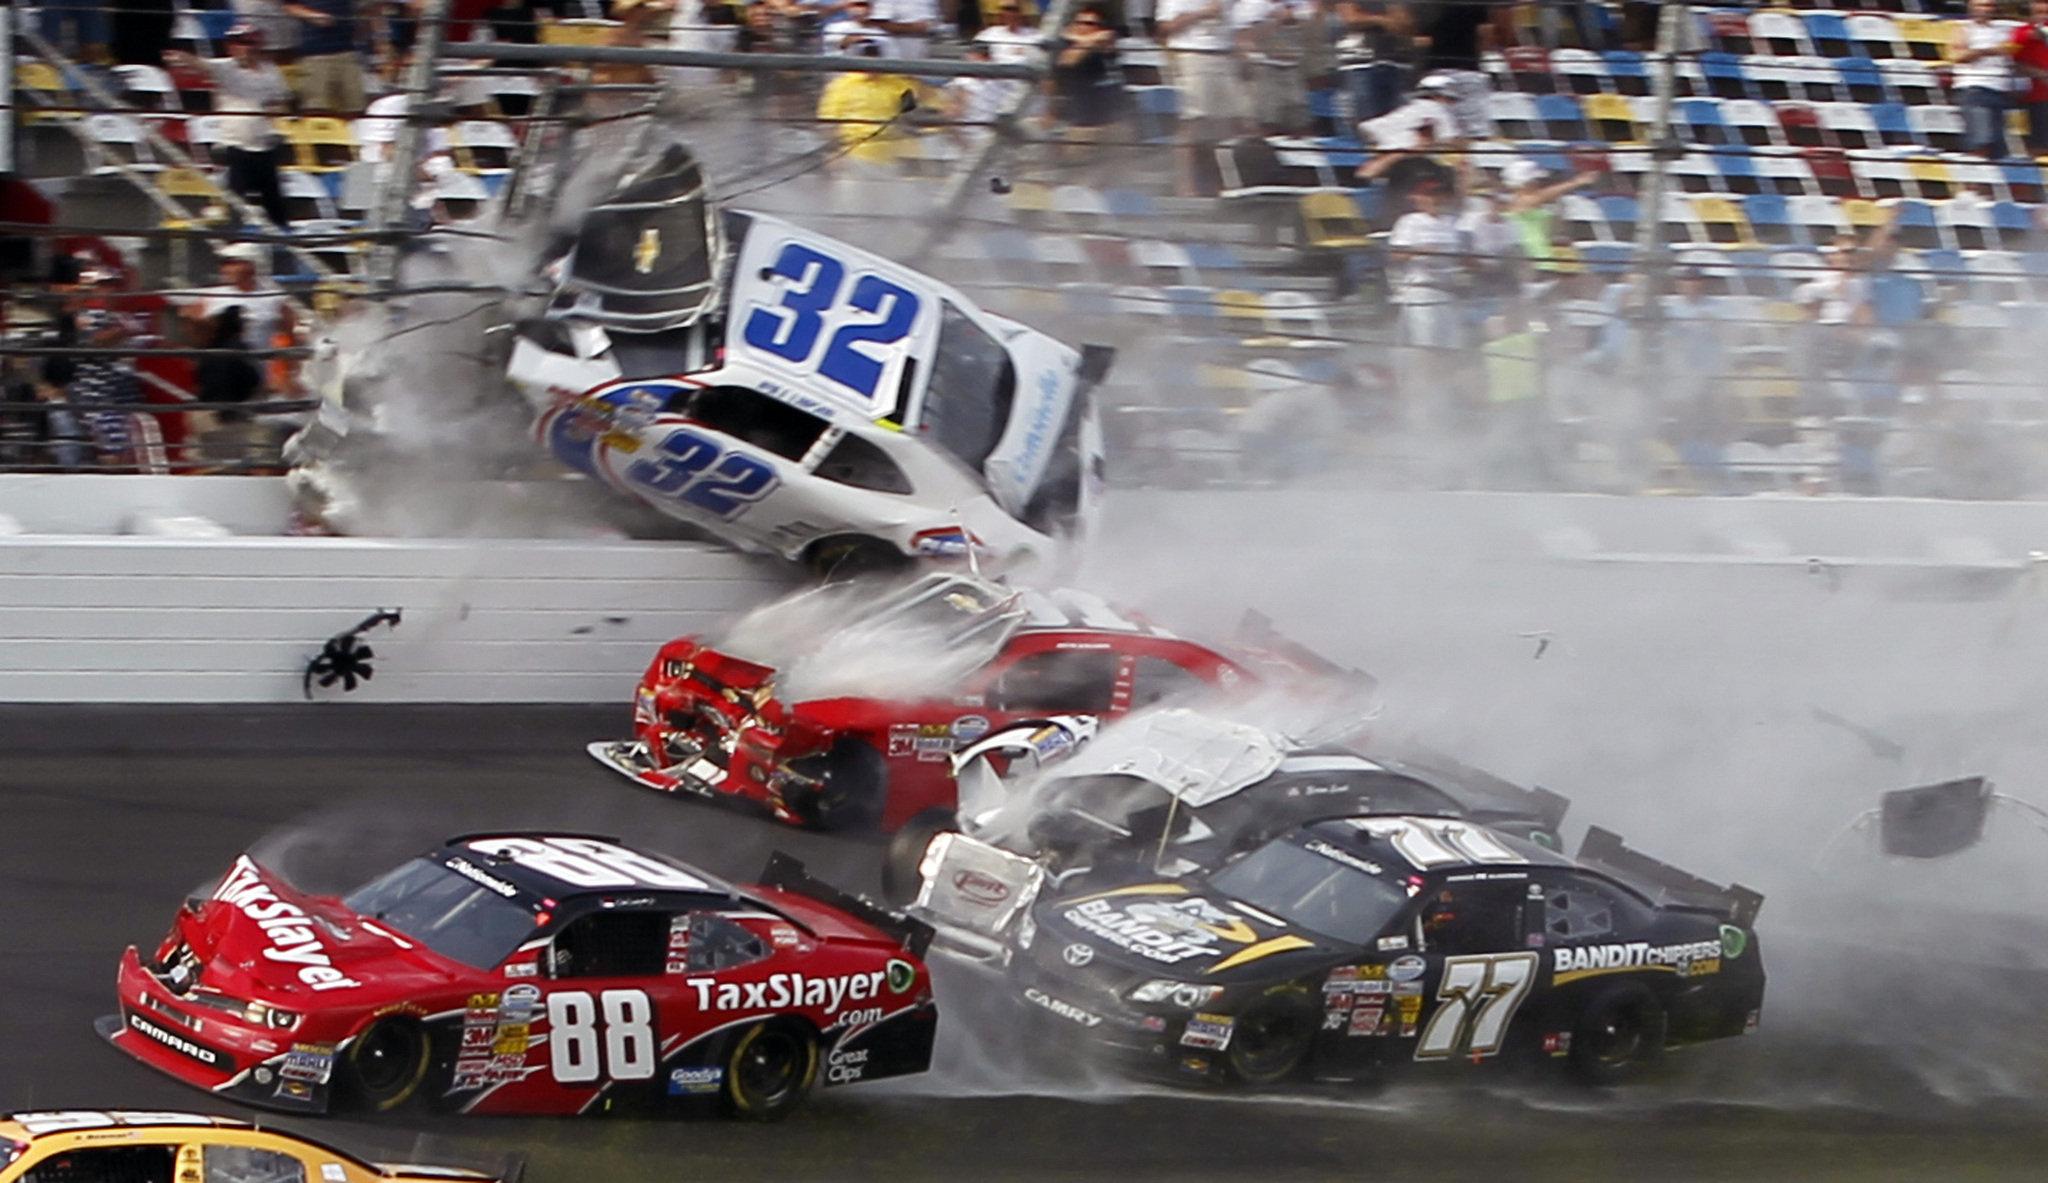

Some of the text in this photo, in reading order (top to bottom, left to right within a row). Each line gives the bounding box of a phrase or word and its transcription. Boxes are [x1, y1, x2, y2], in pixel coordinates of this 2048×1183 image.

[744, 242, 920, 399] 32
[625, 430, 780, 522] 32
[468, 838, 709, 888] 88
[1344, 817, 1530, 871] 77
[212, 854, 362, 991] TaxSlayer
[1077, 899, 1222, 958] BANDIT
[686, 971, 887, 1017] TaxSlayer
[832, 1007, 884, 1027] .com
[1024, 988, 1102, 1027] CAMRY
[1413, 951, 1539, 1061] 77
[130, 1014, 216, 1063] CAMARO
[464, 1027, 492, 1045] 3M
[547, 989, 656, 1083] 88
[828, 1049, 868, 1066] Great
[828, 1064, 864, 1084] Clips
